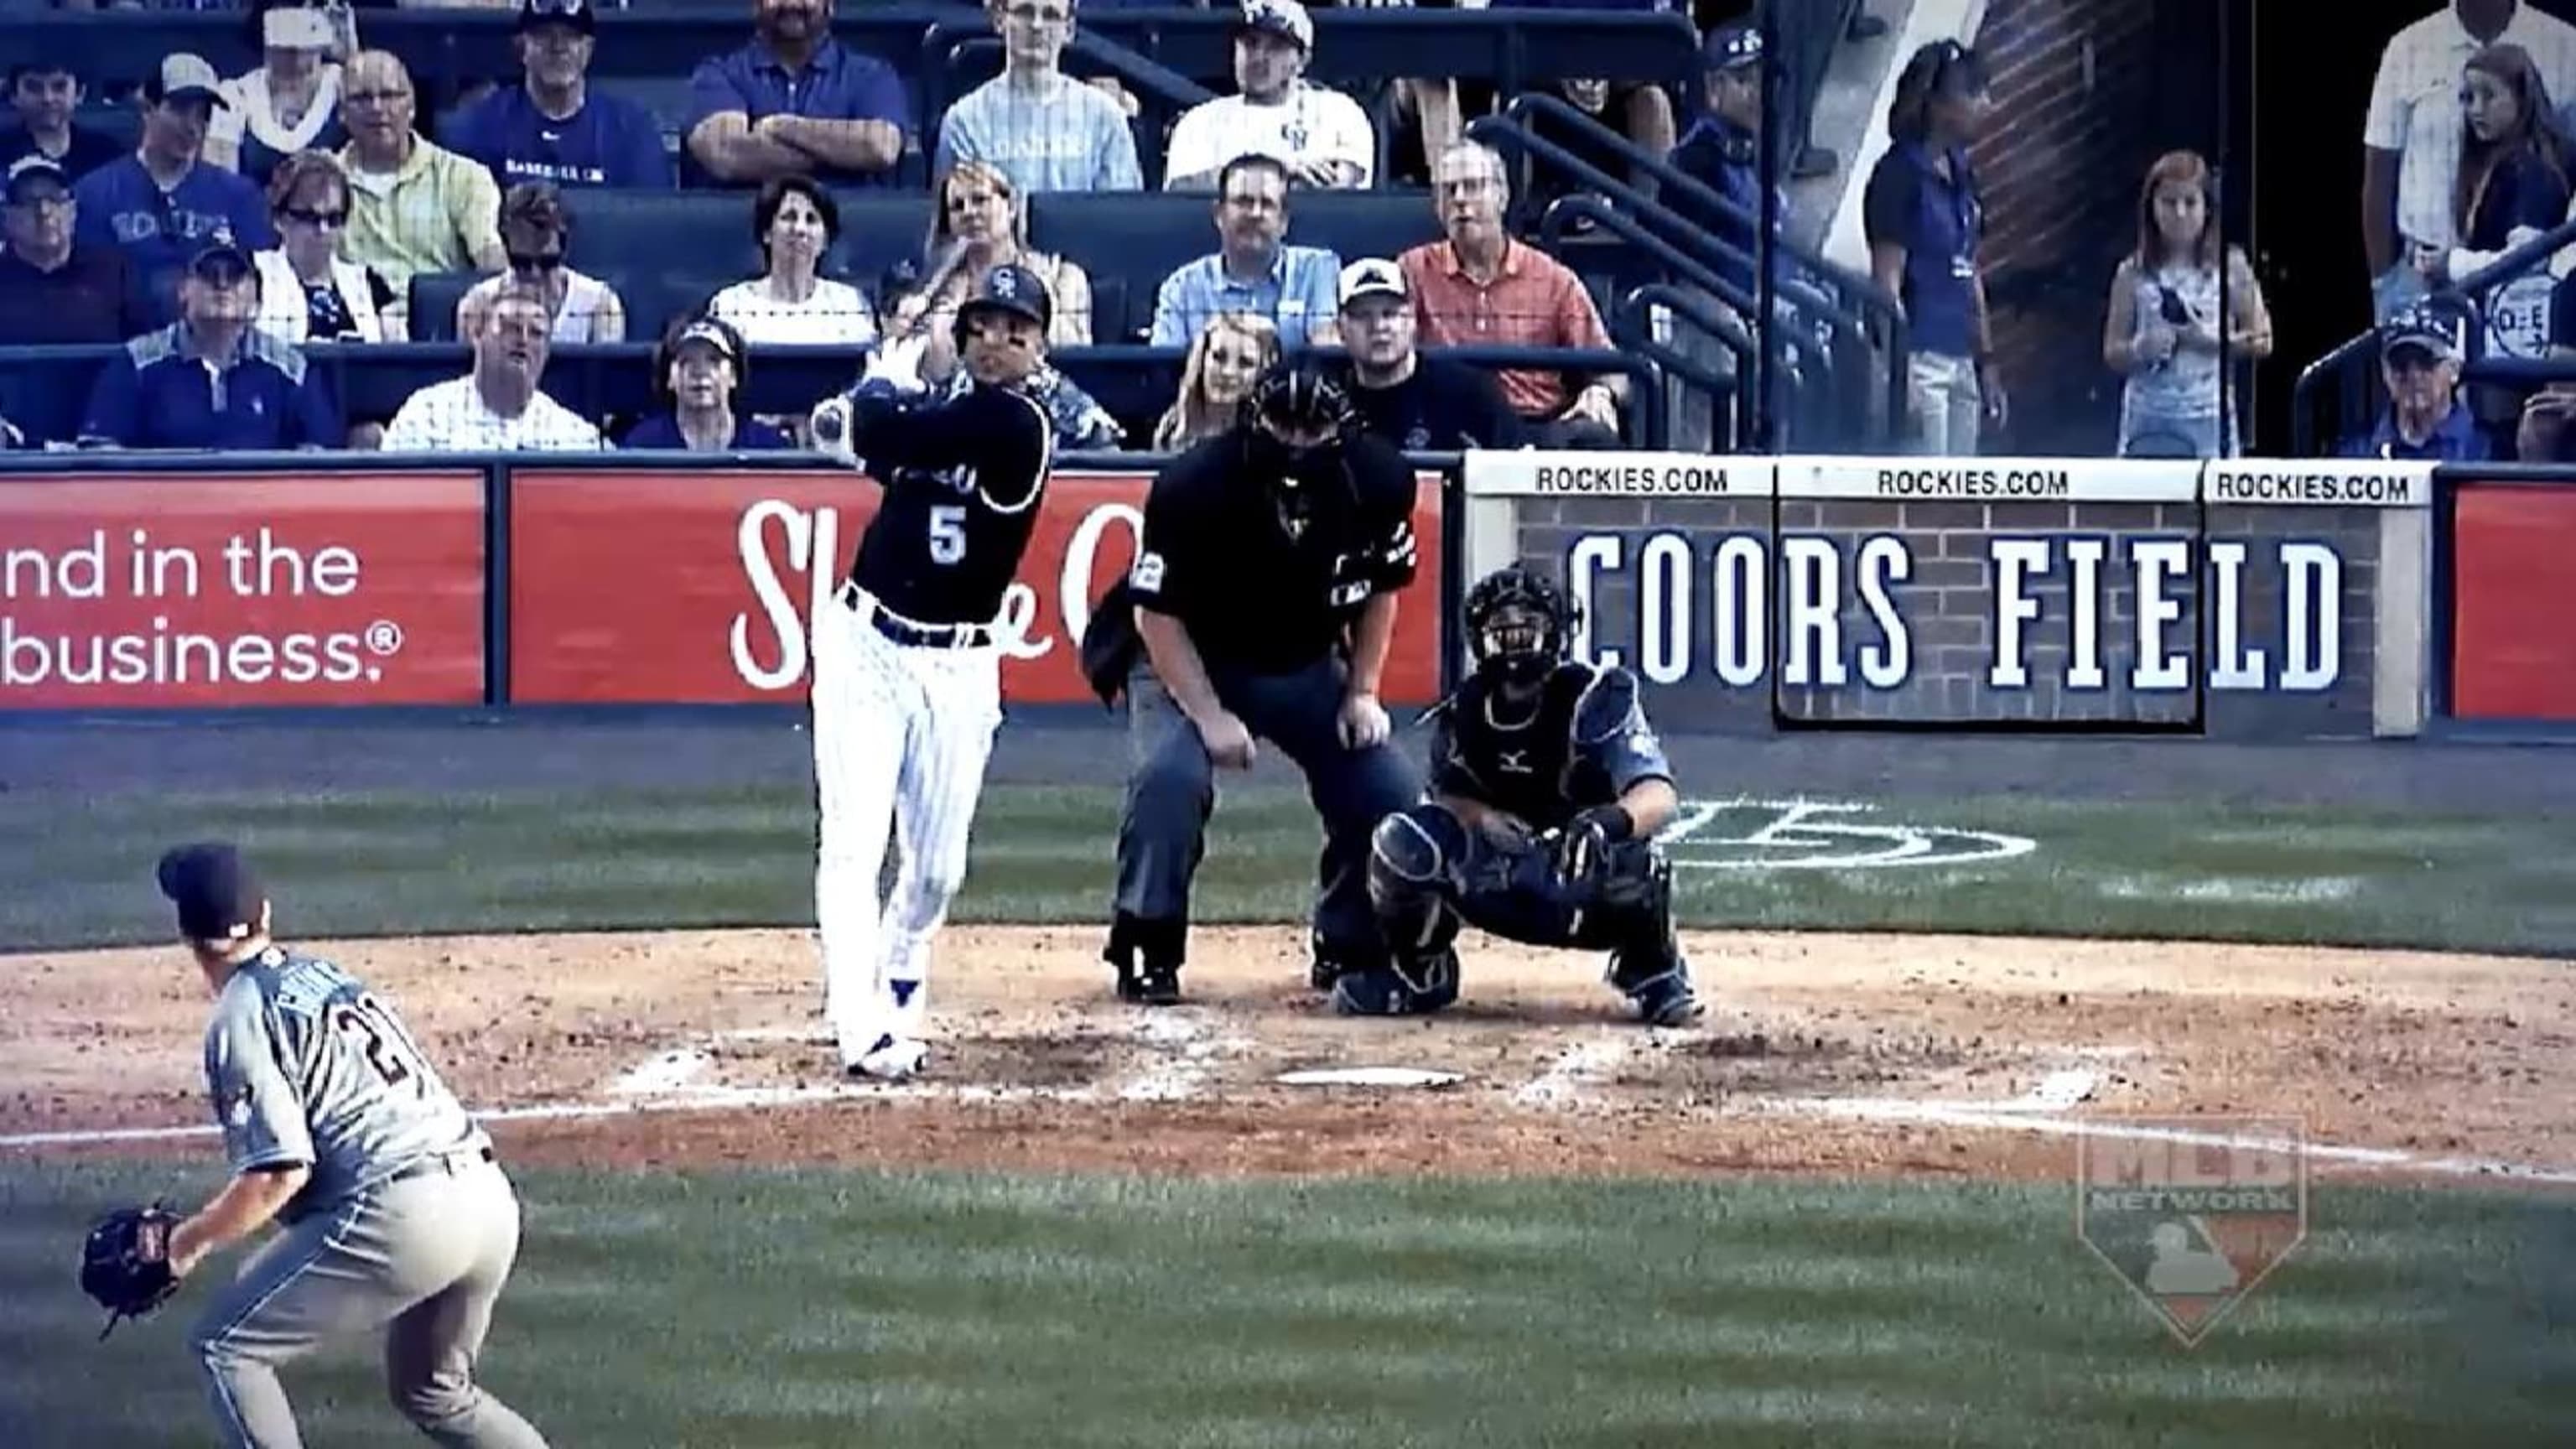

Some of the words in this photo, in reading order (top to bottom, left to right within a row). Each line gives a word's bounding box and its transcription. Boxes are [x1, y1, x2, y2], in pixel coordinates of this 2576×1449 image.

[1537, 467, 1728, 493] ROCKIES.COM
[1877, 470, 2069, 496] ROCKIES.COM
[2216, 473, 2409, 501] ROCKIES.COM
[929, 505, 967, 565] 5
[131, 529, 200, 596] in
[223, 527, 360, 596] the
[1570, 532, 1913, 690] COORS
[1990, 538, 2341, 691] FIELD
